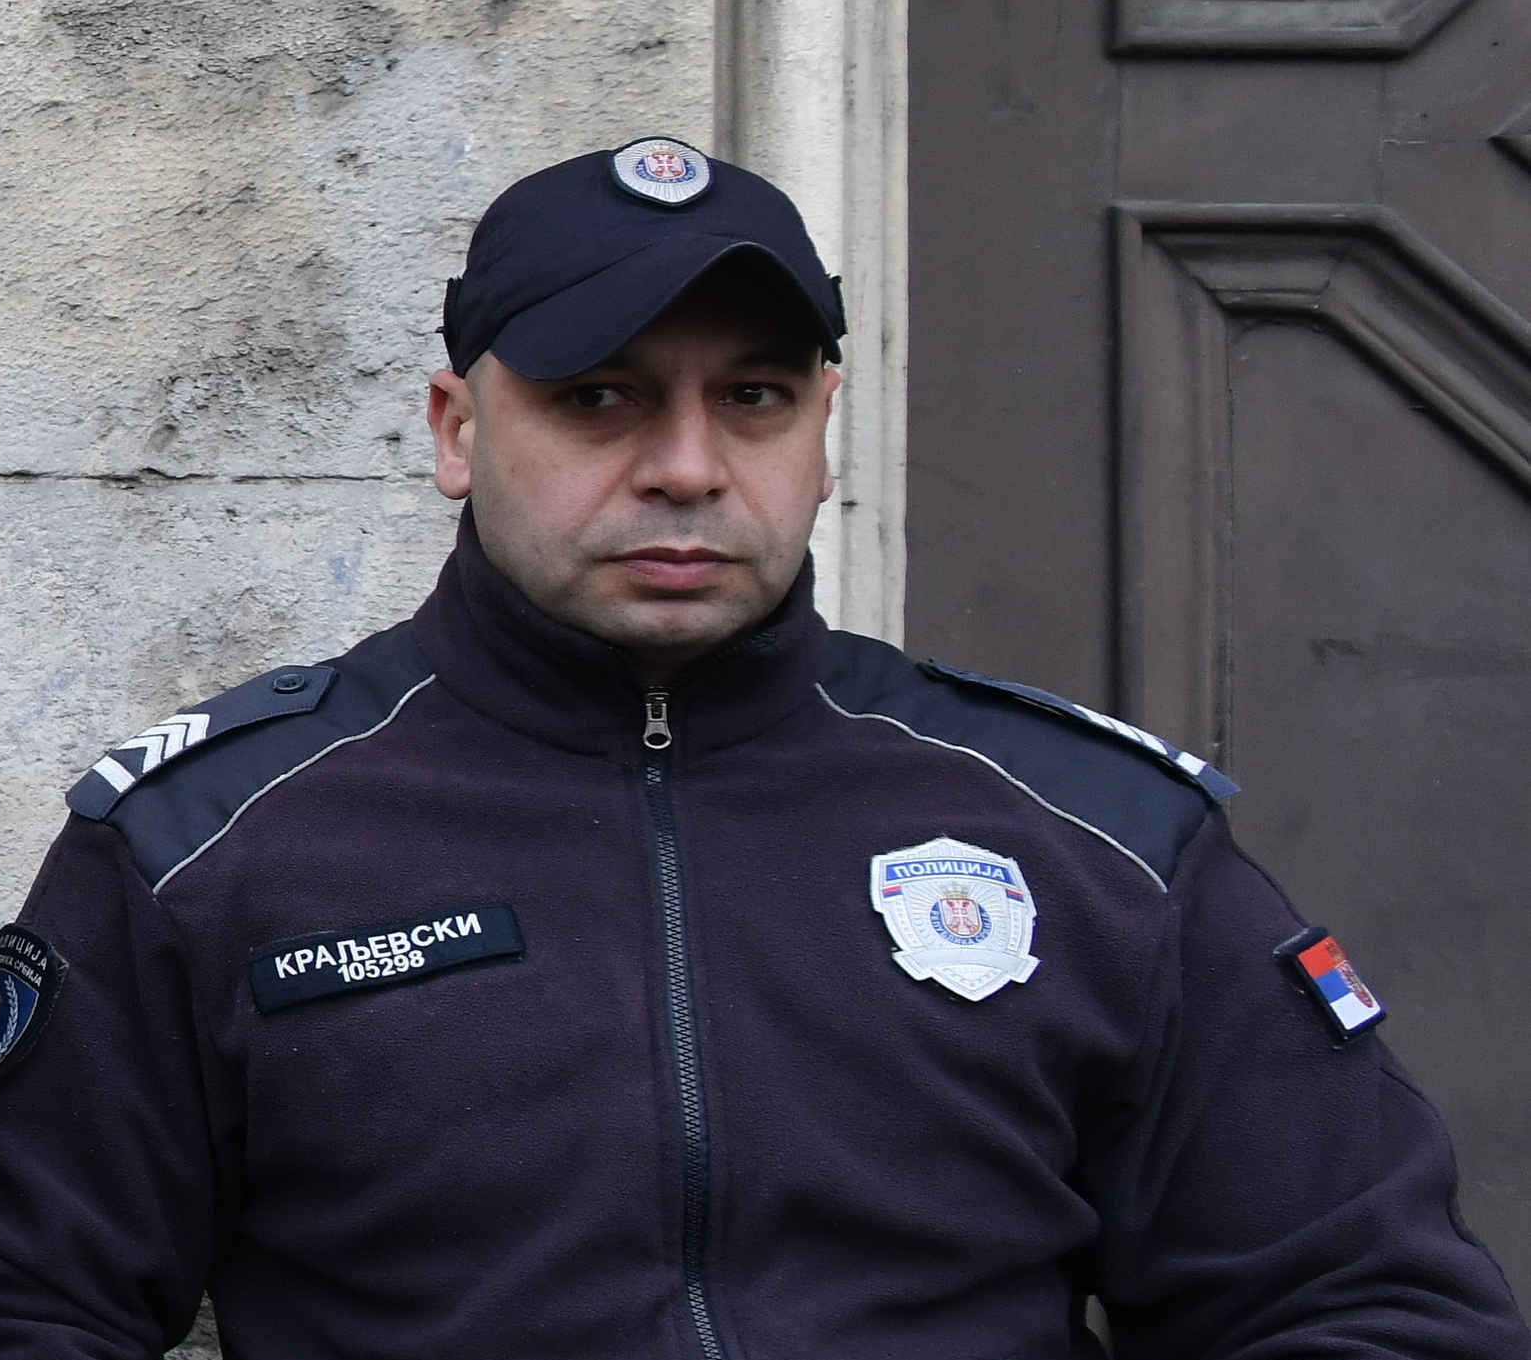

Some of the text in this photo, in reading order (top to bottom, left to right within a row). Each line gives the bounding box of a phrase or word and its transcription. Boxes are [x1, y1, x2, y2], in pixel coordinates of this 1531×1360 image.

[892, 860, 1006, 881] ПОЛИЦИЈА
[274, 912, 483, 979] КРАЉЕВСКИ
[337, 949, 426, 983] 105298
